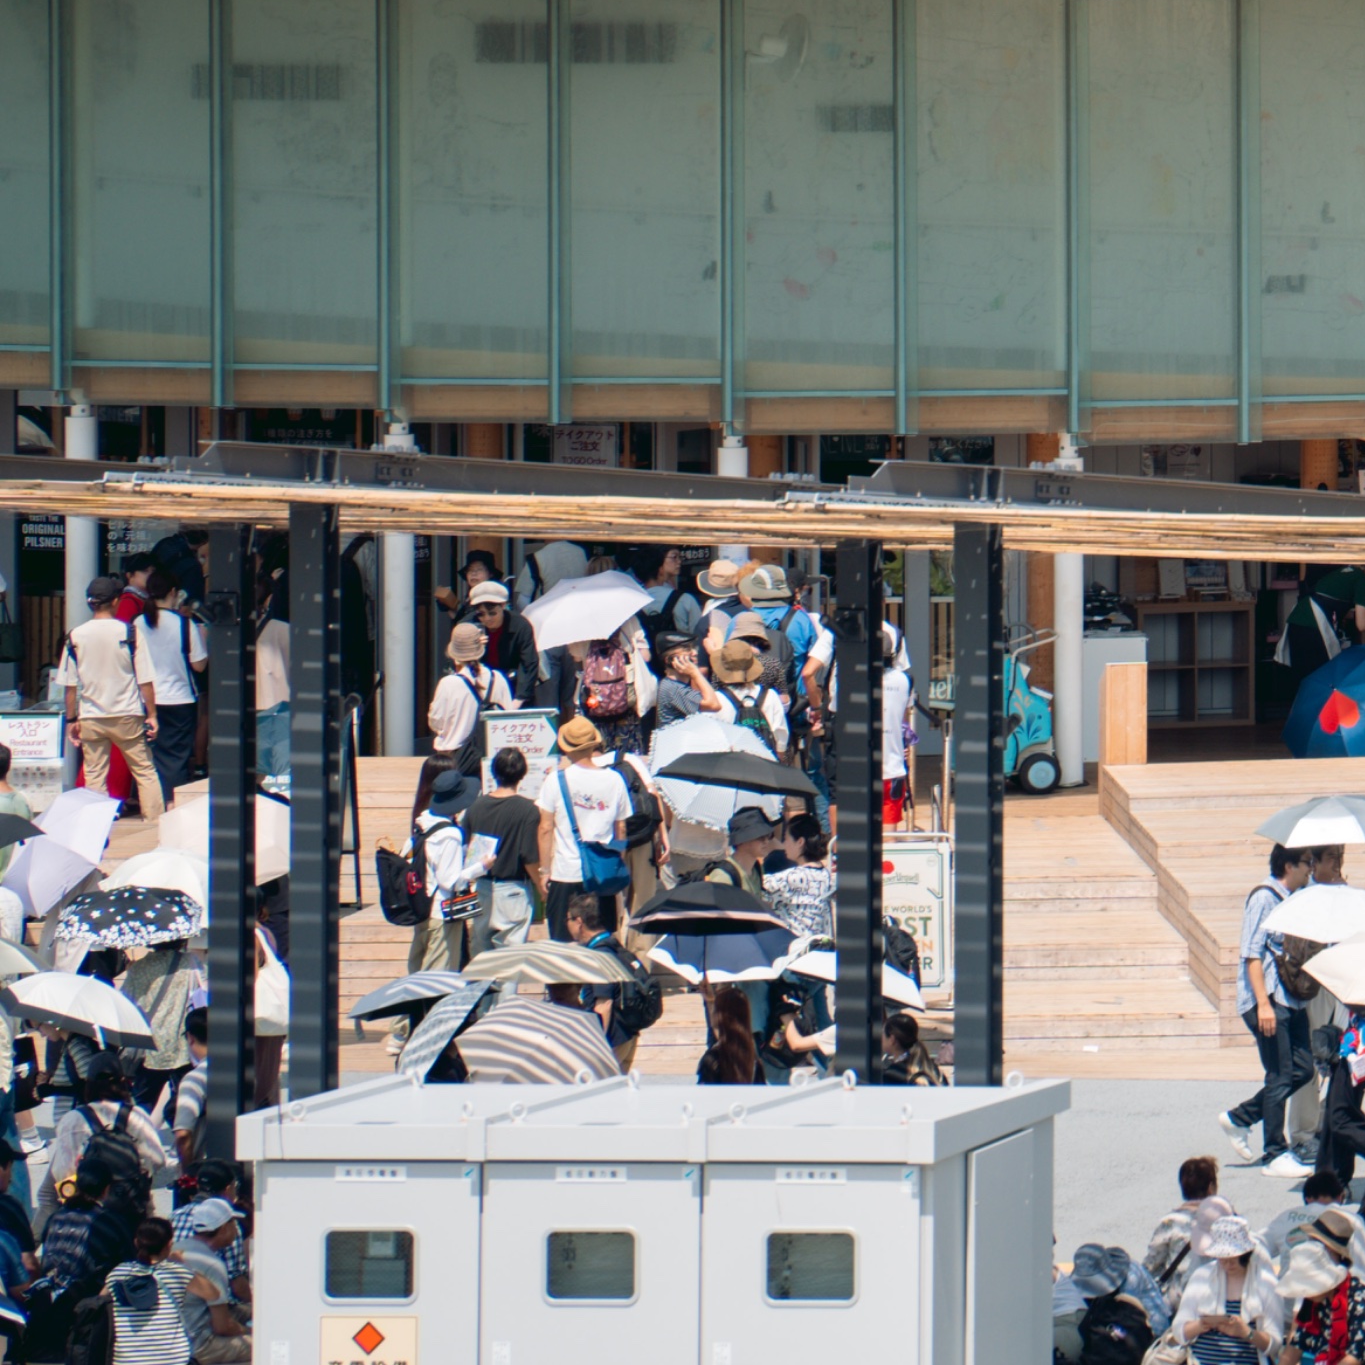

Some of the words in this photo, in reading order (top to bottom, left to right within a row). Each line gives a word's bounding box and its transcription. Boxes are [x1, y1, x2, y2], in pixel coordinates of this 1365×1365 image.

[22, 523, 65, 535] ORIGINAL
[24, 536, 63, 548] PILSNER
[491, 723, 546, 733] テイクアウト
[505, 733, 533, 743] ご注文
[891, 905, 932, 913] WORLD'S
